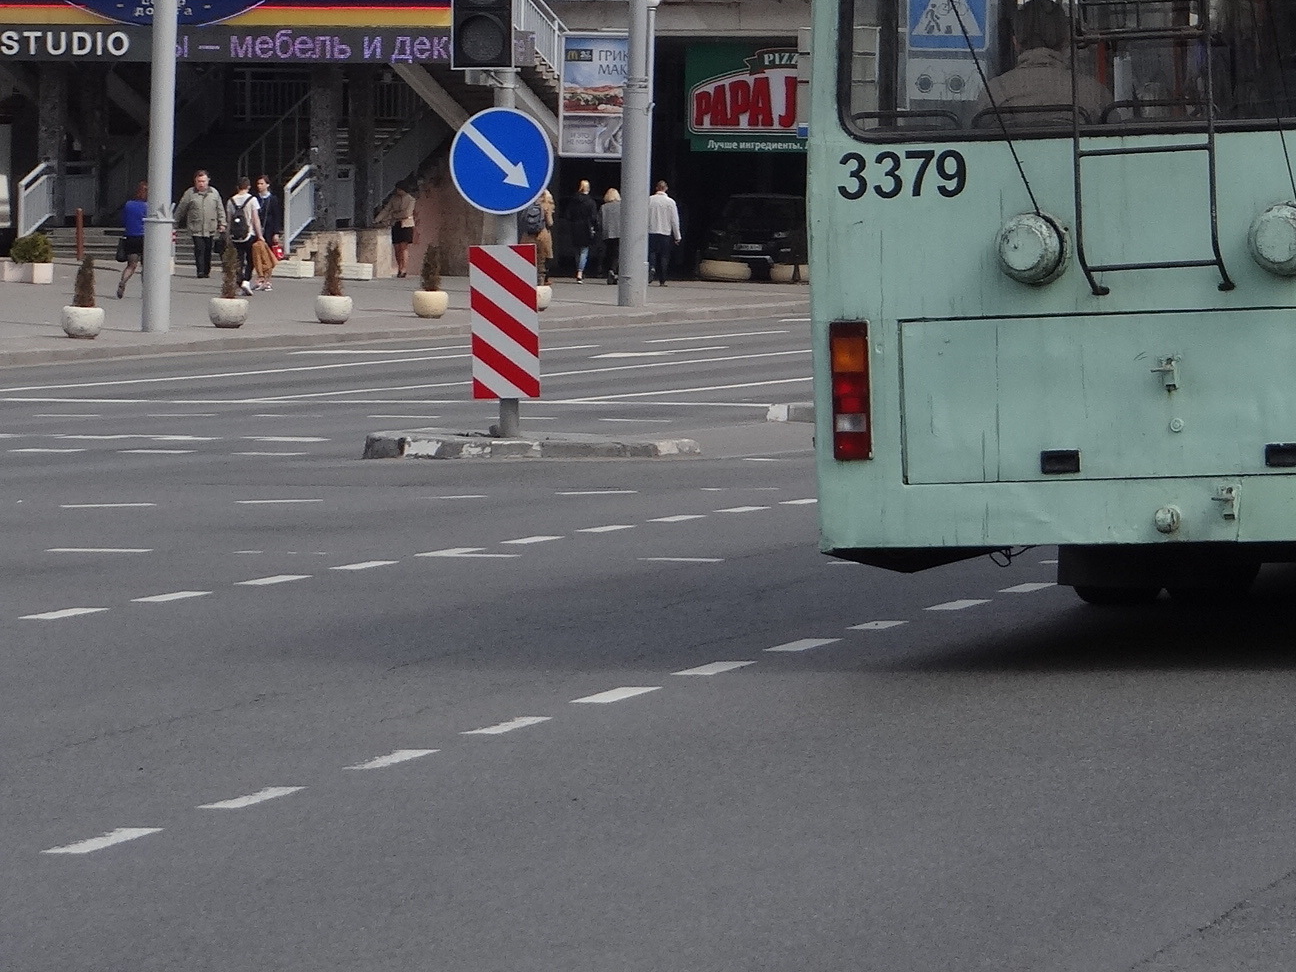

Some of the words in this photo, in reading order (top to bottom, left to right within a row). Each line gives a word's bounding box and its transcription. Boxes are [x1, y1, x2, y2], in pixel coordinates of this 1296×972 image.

[0, 31, 129, 56] STUDIO
[230, 29, 351, 59] мебель
[364, 36, 382, 58] и
[391, 35, 452, 64] дек
[764, 52, 799, 65] PIZZ
[695, 75, 774, 127] PAPA
[837, 149, 967, 201] 3379
